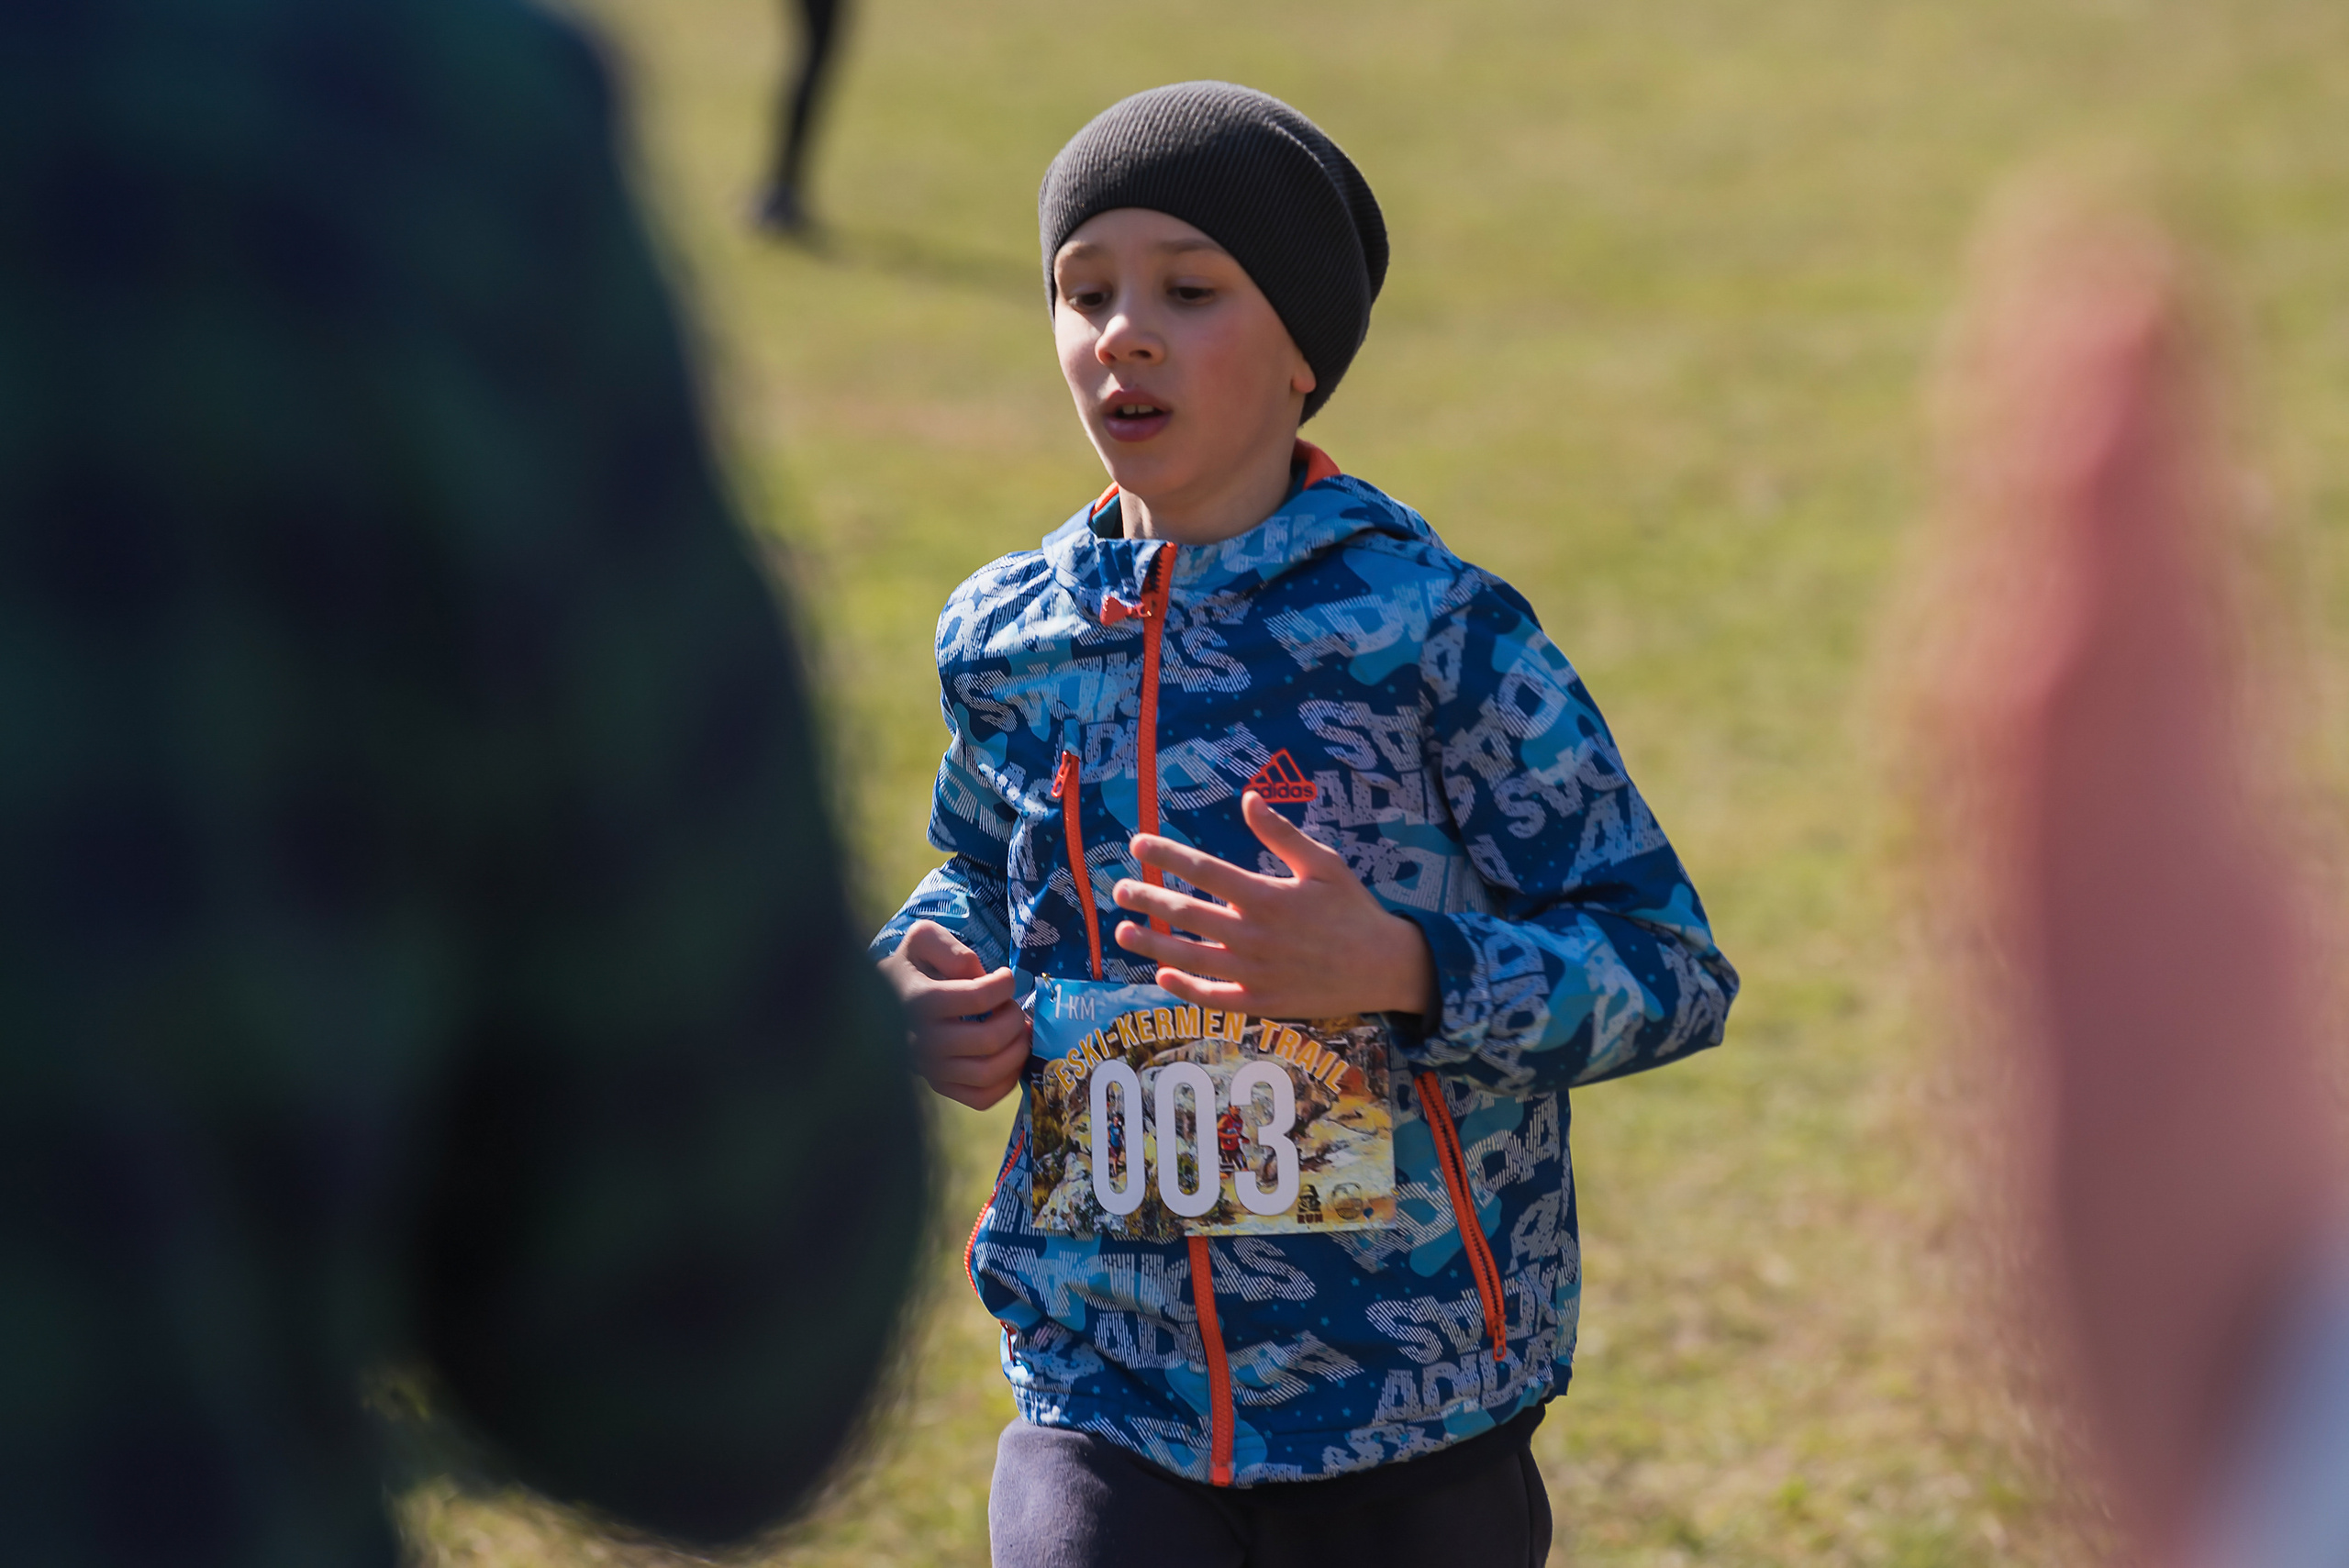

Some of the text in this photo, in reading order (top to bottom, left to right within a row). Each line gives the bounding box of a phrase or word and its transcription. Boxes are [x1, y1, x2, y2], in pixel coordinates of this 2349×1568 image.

[1054, 983, 1097, 1022] 1 KM
[1054, 1006, 1351, 1095] ESKI-KERMEN TRAIL
[1089, 1059, 1300, 1218] 003
